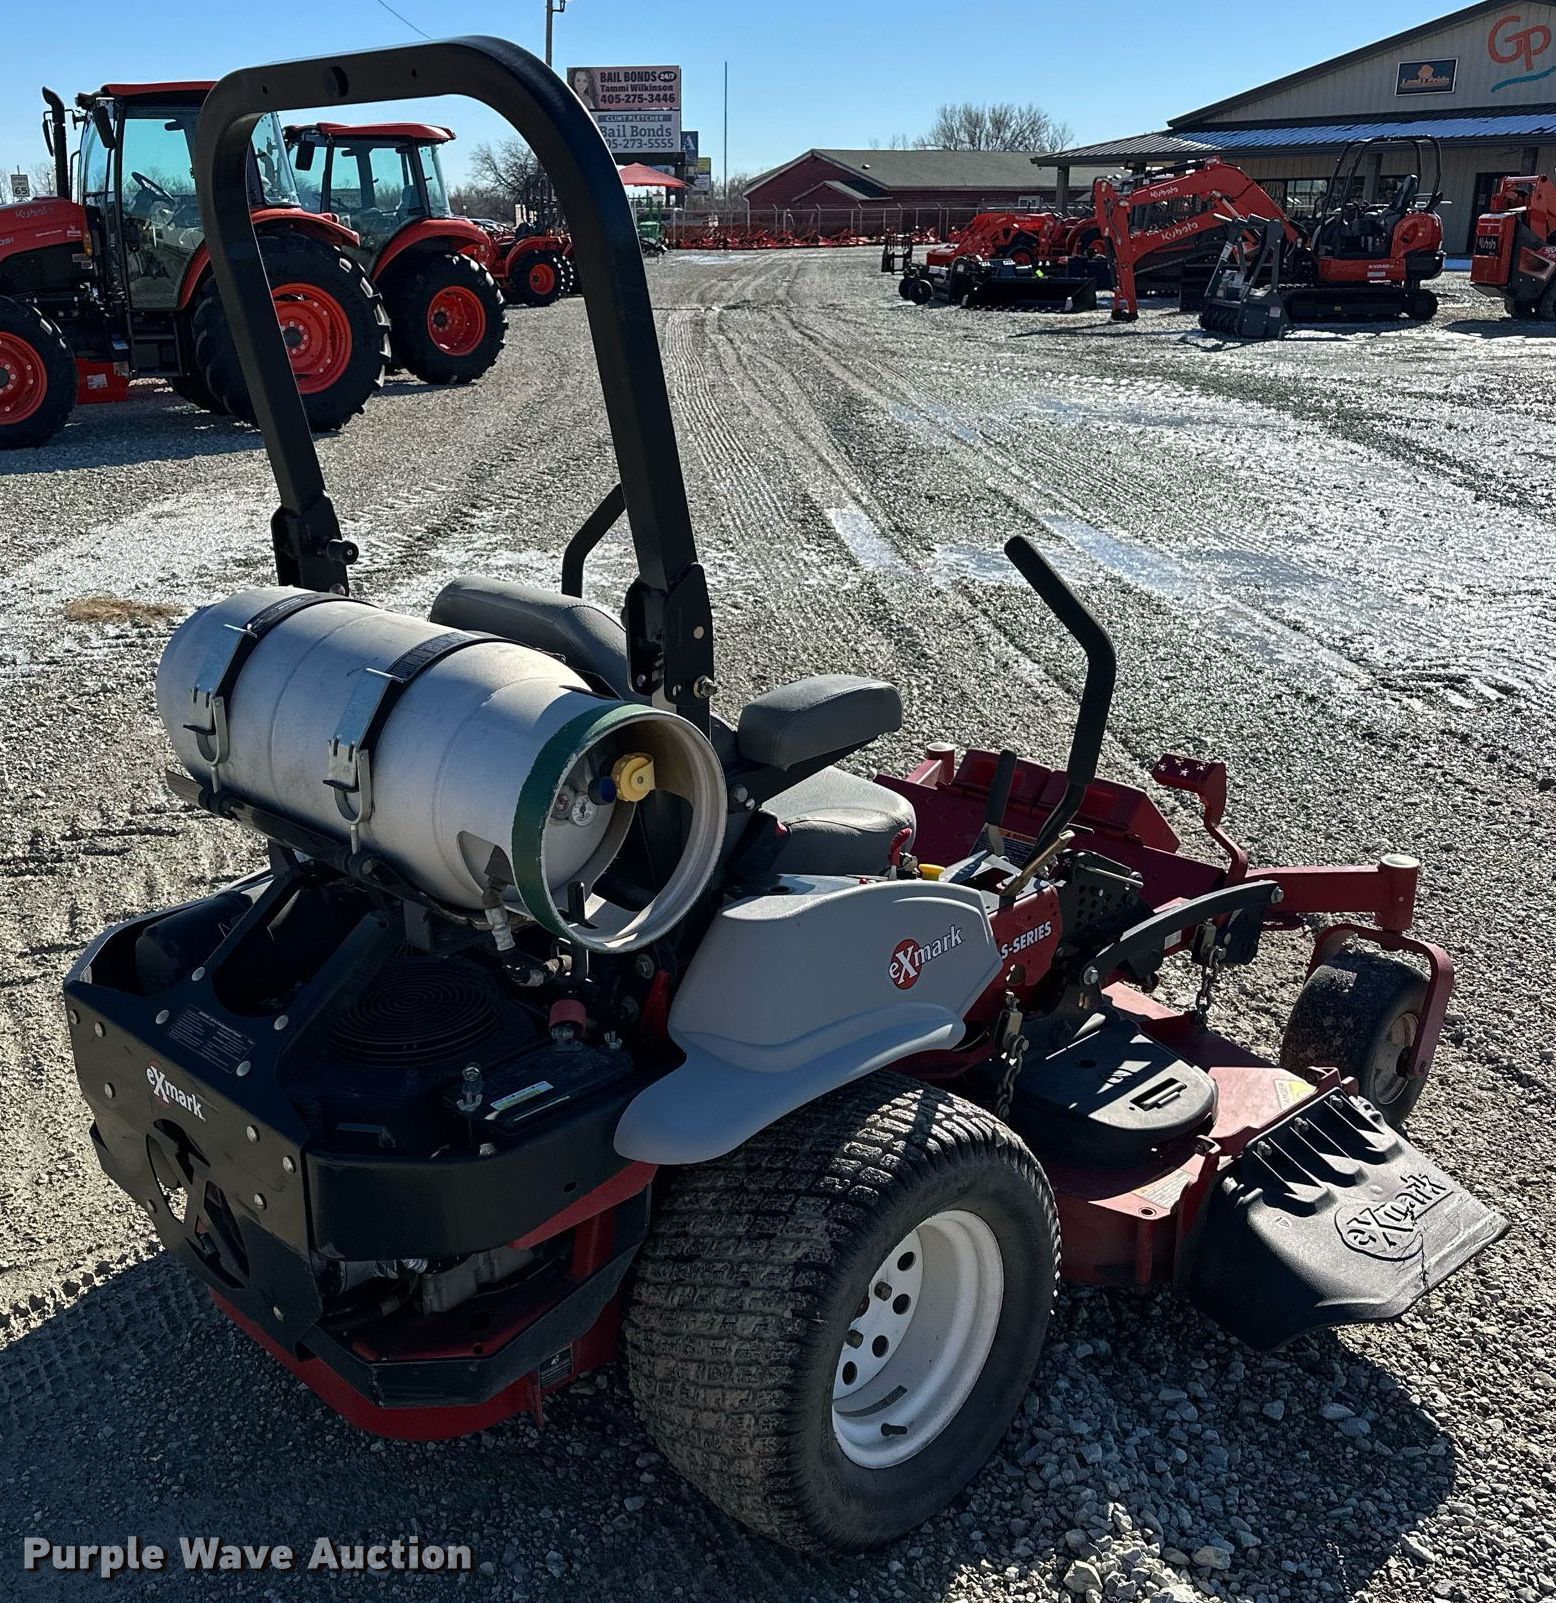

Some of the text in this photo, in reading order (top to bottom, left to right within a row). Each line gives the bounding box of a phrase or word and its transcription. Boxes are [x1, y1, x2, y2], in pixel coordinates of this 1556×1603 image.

[600, 72, 622, 83] BAIL
[624, 71, 657, 82] BONDS
[600, 83, 674, 92] Tammi Wilkinson
[600, 94, 675, 104] 405-275-3446
[600, 125, 672, 138] Bail Bonds
[605, 138, 674, 149] 05-273-5555
[15, 186, 28, 194] 65
[1150, 187, 1178, 198] Kubota
[1161, 222, 1198, 240] Kubota
[1000, 920, 1052, 961] S-SERIES
[888, 926, 964, 985] eXmark
[146, 1064, 206, 1121] eXmark
